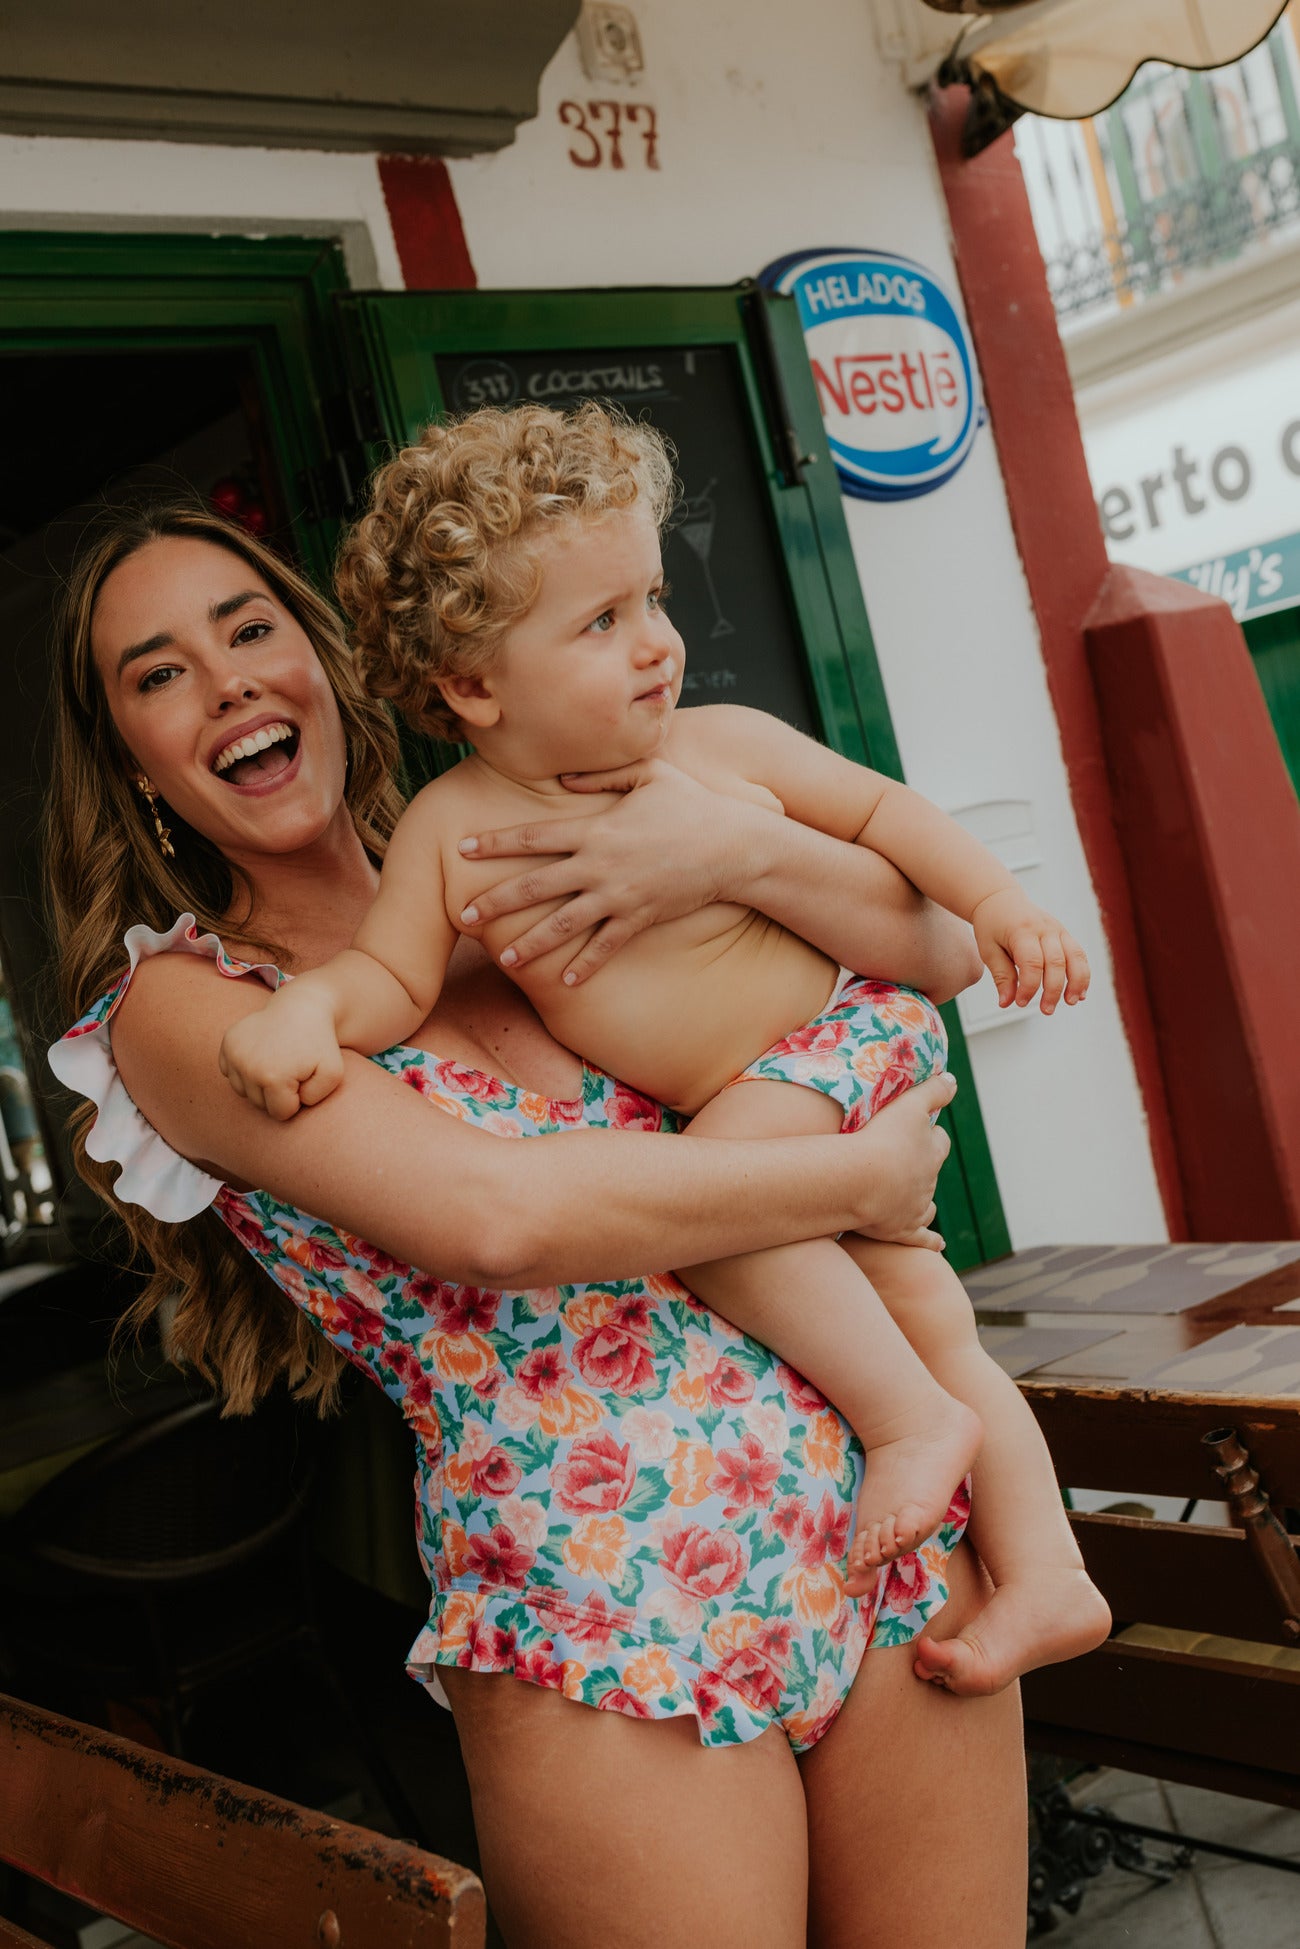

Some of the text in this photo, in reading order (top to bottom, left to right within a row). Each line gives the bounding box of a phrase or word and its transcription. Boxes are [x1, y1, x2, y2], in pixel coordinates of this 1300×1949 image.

[558, 100, 661, 172] 377
[804, 272, 926, 314] HELADOS
[528, 364, 664, 398] COCKTAILS
[1188, 548, 1283, 621] lly's
